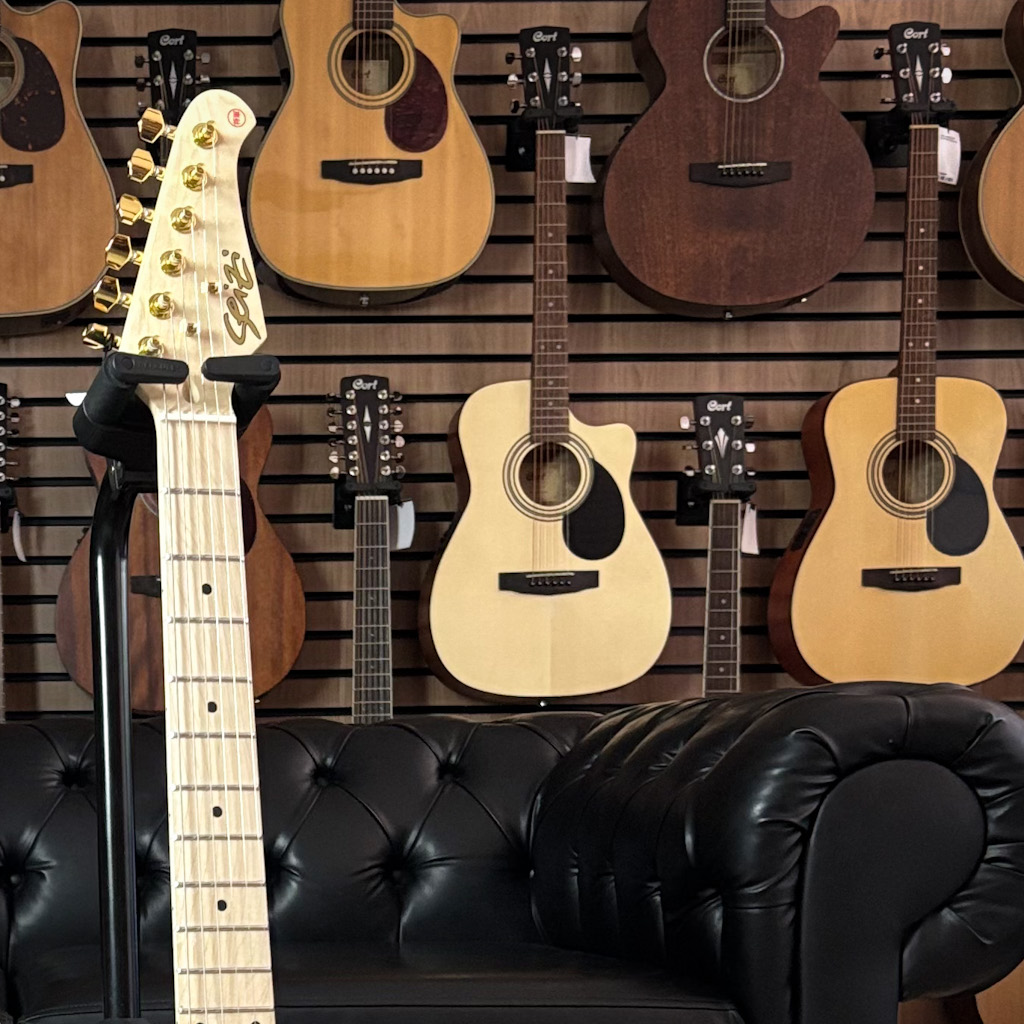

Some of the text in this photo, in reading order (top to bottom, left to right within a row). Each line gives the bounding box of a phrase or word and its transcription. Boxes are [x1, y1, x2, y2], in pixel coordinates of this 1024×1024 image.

[532, 31, 558, 43] Cort
[903, 27, 929, 39] Cort
[159, 35, 185, 46] Cort
[352, 378, 378, 390] Cort
[707, 400, 733, 411] Cort
